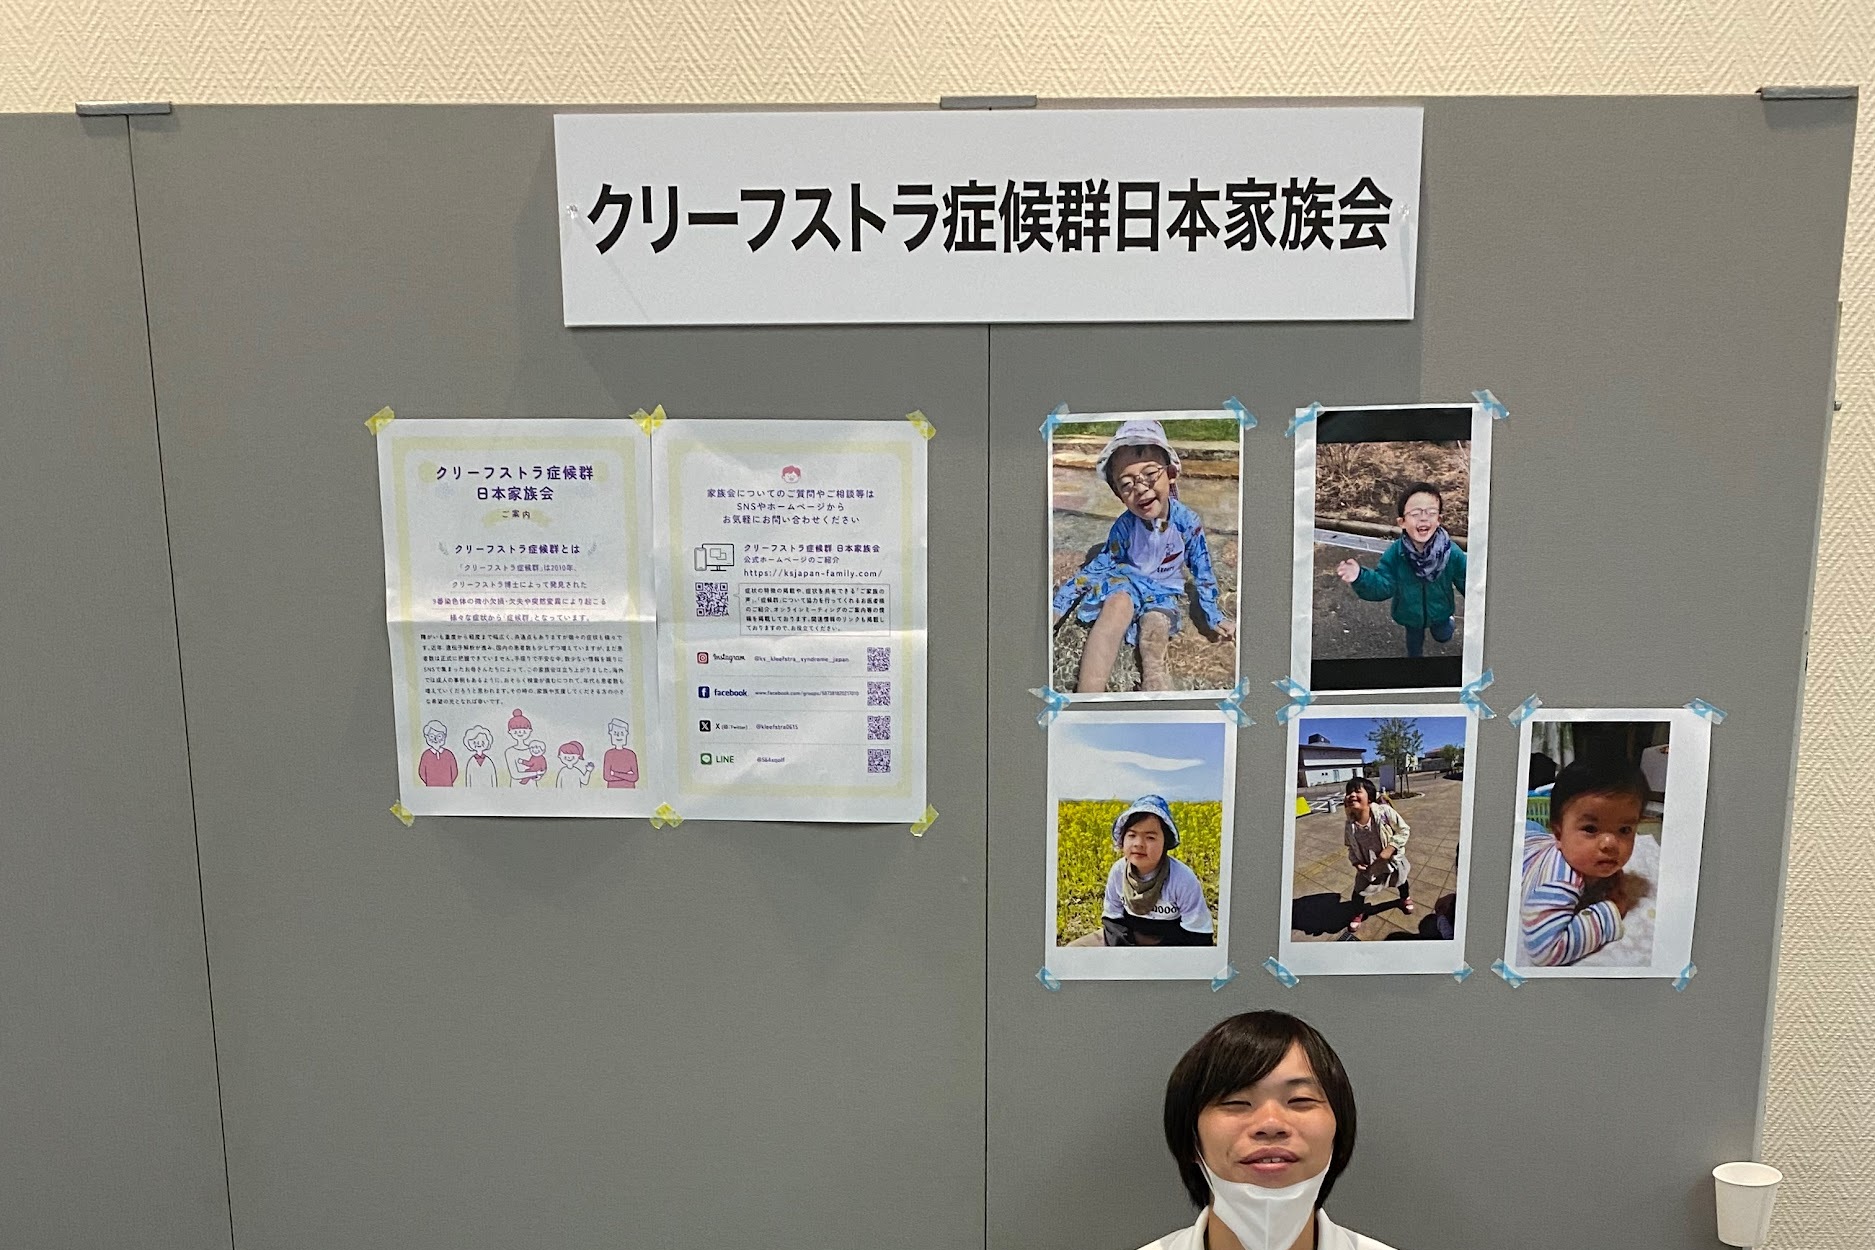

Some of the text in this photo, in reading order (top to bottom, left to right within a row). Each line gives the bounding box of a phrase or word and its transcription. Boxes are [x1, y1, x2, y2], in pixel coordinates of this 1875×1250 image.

[586, 177, 1395, 253] クリーフストラ症候群日本家族会
[436, 465, 594, 481] クリーフストラ症候群
[477, 486, 554, 501] 日本家族会
[707, 488, 874, 499] 家族会についてのご質問やご相談等は
[737, 502, 845, 512] SNSやホームページから
[502, 509, 531, 519] ご案内
[722, 515, 860, 525] お気軽にお問い合わせください
[454, 543, 580, 555] クリーフストラ症候群とは
[744, 543, 881, 553] クリーフストラ症候群 日本家族会
[744, 555, 840, 564] 公式ホームページのご紹介
[744, 568, 883, 579] https://ksjapan-family.com/
[713, 653, 746, 664] Instagram
[714, 688, 747, 697] facebook
[716, 755, 734, 763] LINE
